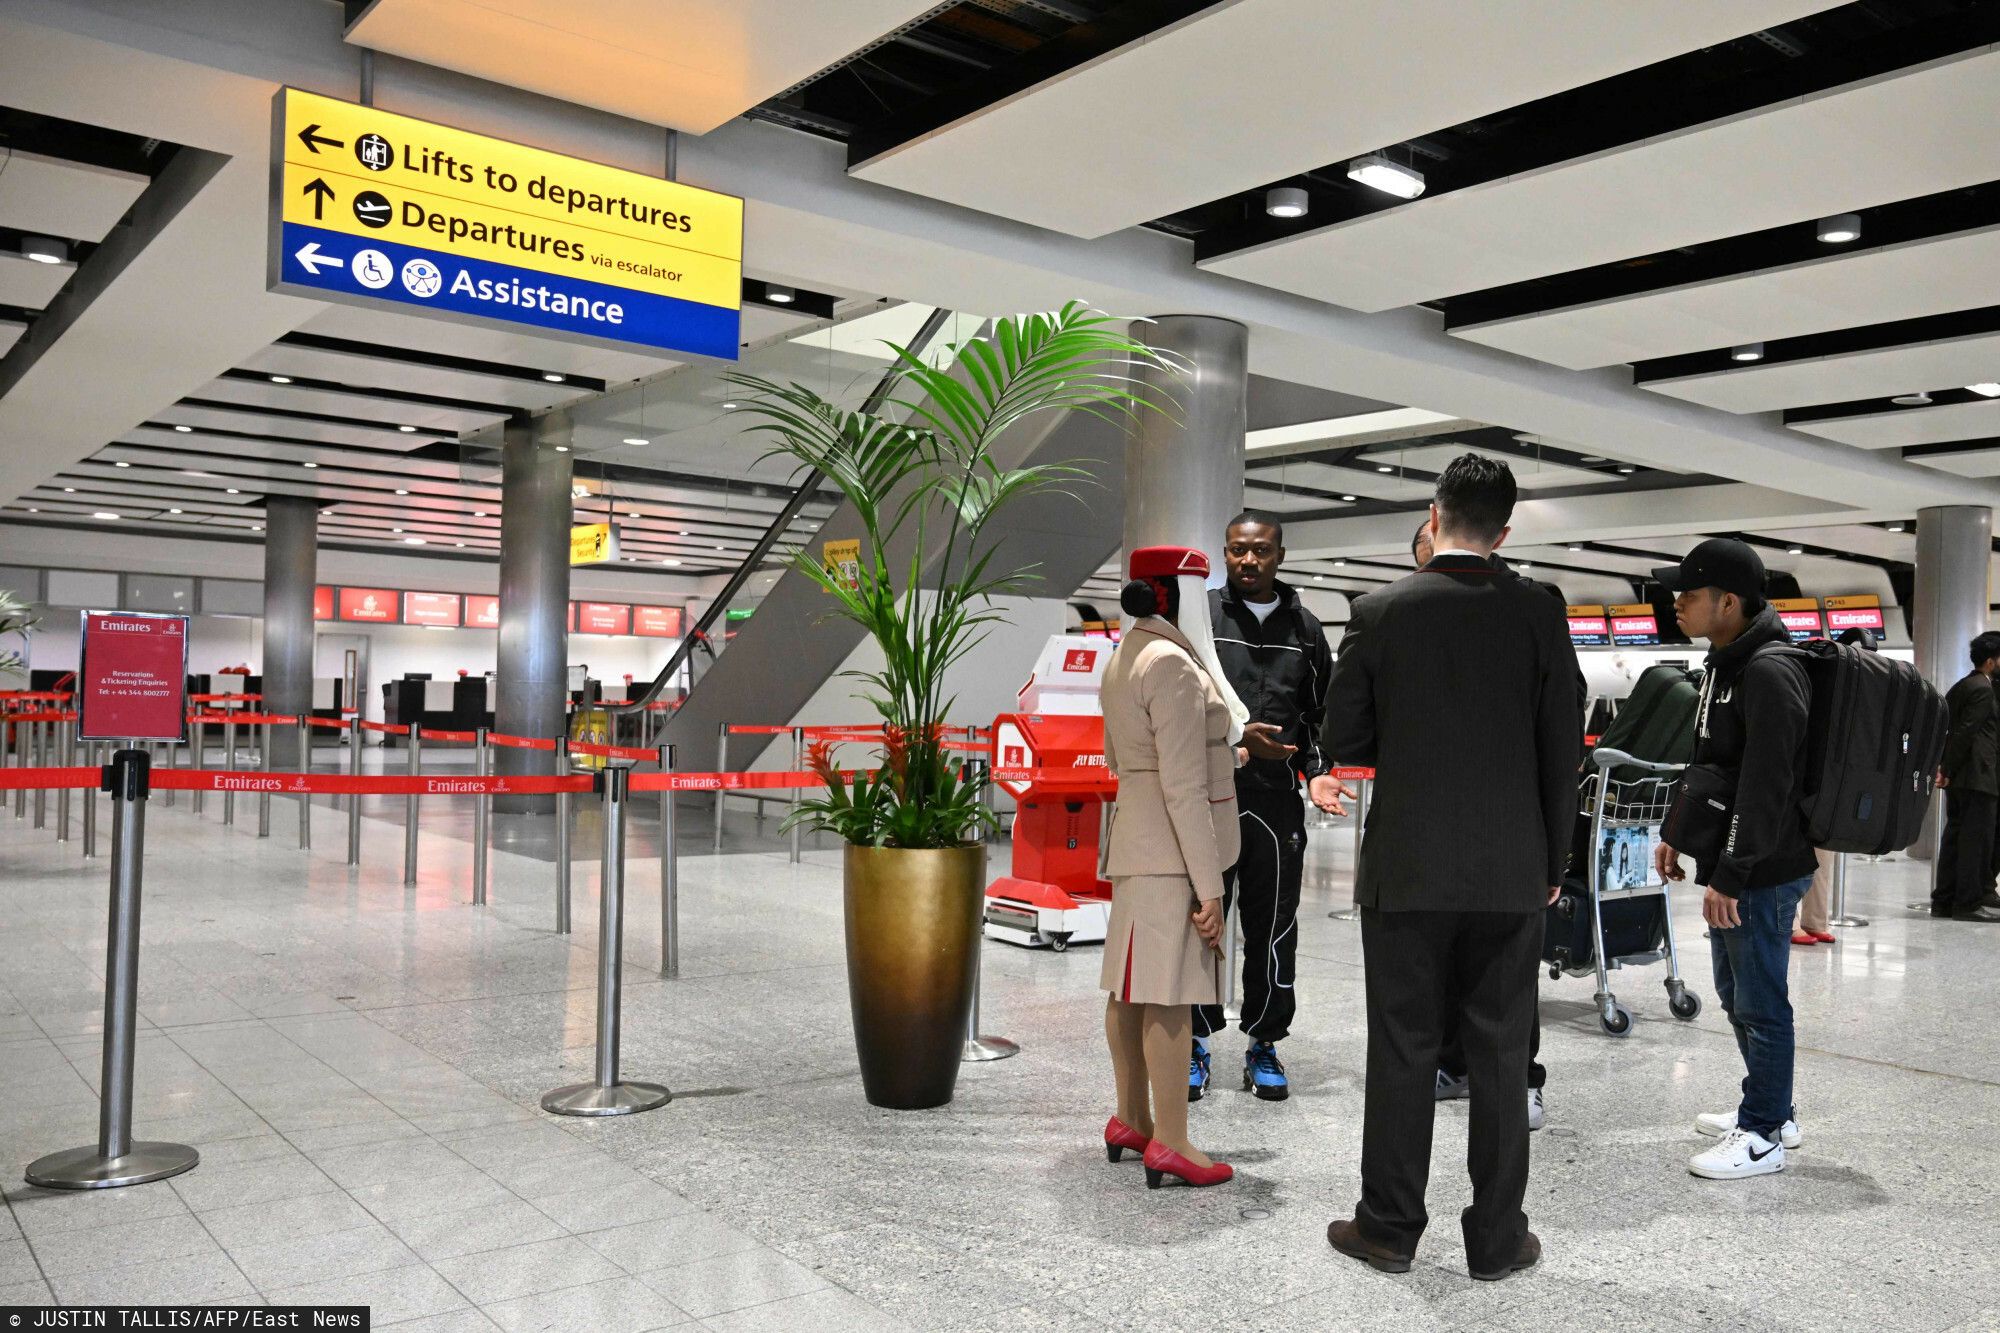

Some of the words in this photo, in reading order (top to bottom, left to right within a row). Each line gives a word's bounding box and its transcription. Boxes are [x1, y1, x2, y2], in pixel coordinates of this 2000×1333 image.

[403, 144, 474, 184] Lifts
[484, 165, 518, 193] to
[527, 176, 692, 234] departures
[402, 202, 585, 262] Departures
[591, 253, 613, 268] via
[617, 258, 683, 283] escalator
[450, 269, 624, 325] Assistance
[1615, 621, 1653, 630] Emirates
[1780, 616, 1816, 626] mirates
[1832, 614, 1877, 625] Emirates
[101, 620, 151, 632] Emirates
[1072, 755, 1087, 768] FLY
[993, 769, 1030, 780] Emirates
[1337, 771, 1364, 779] Emirates
[214, 775, 282, 790] Emirates
[428, 780, 486, 792] Emirates
[671, 776, 722, 789] Emirates
